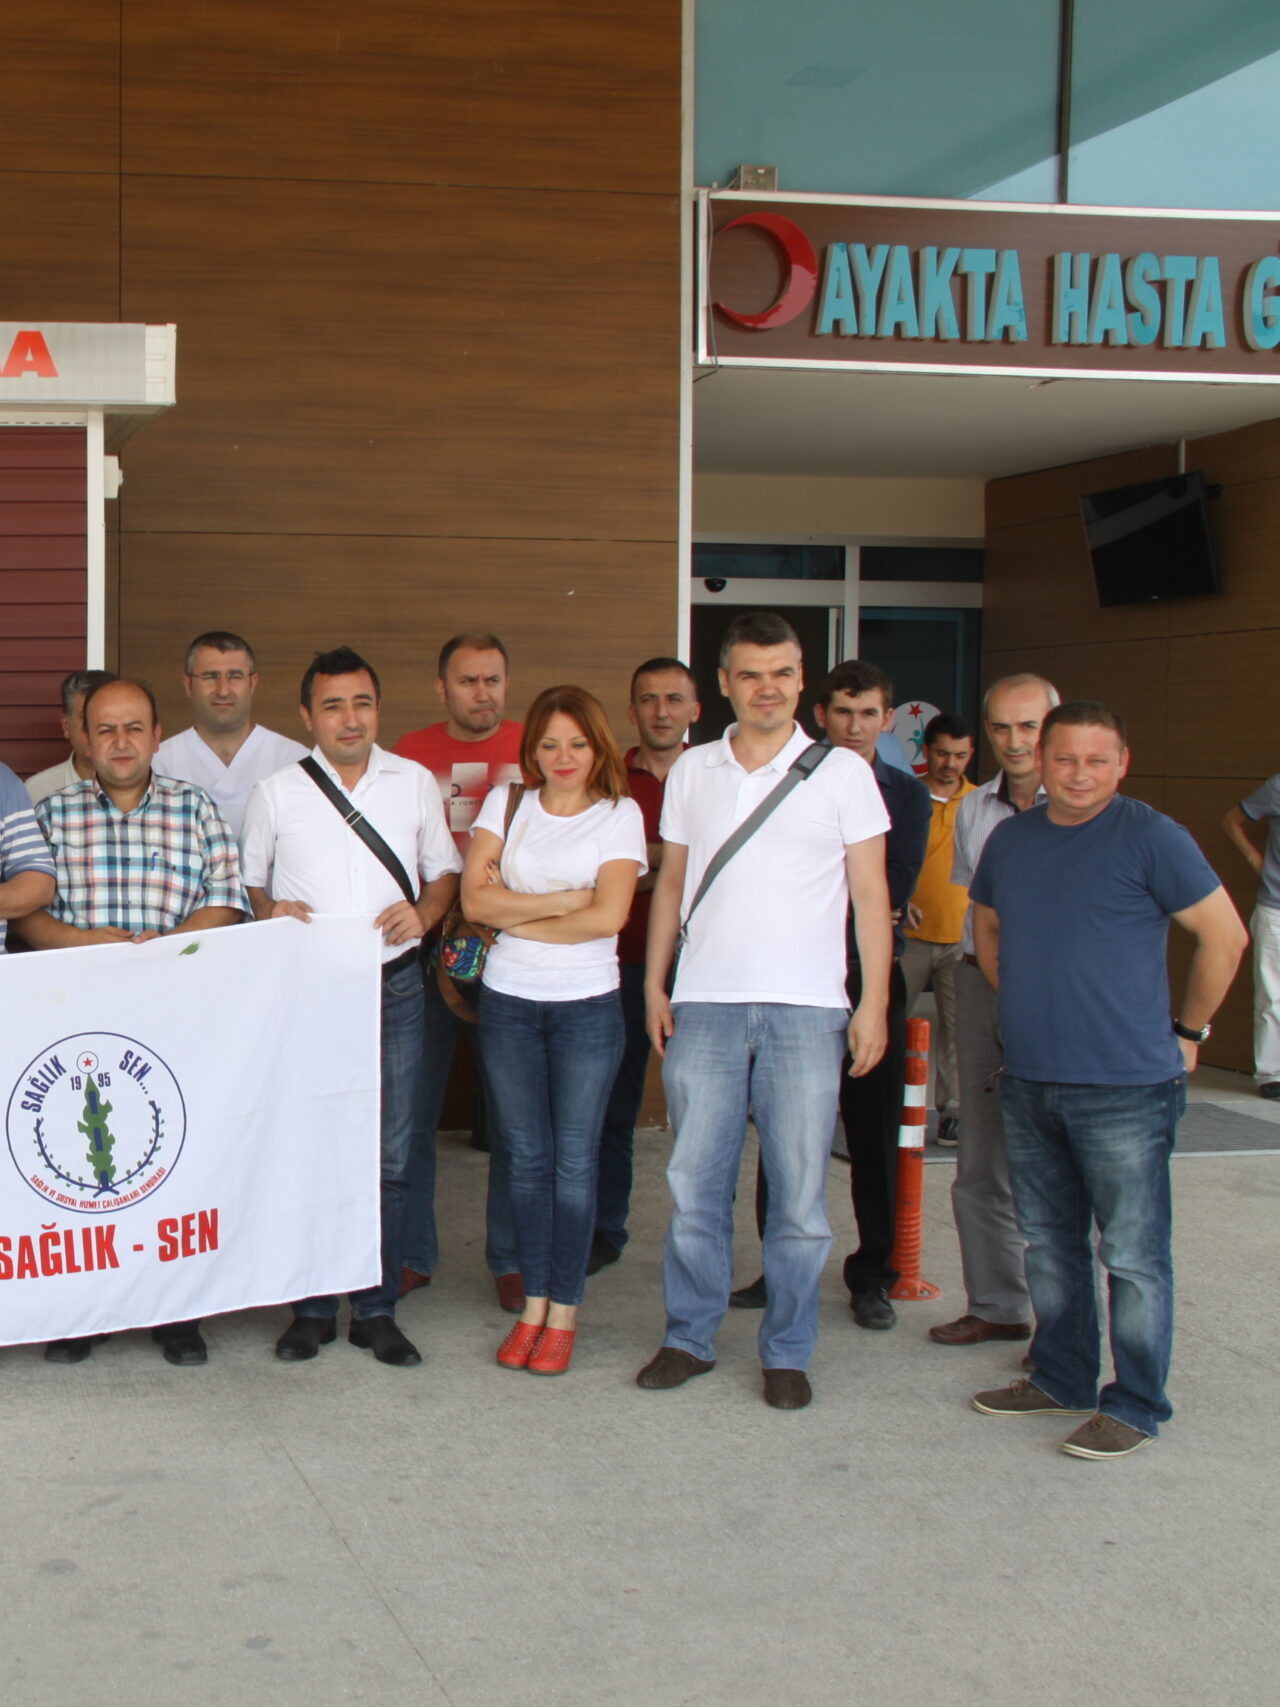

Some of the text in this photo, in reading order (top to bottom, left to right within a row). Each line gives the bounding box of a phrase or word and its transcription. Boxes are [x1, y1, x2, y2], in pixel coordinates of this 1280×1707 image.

[815, 241, 1028, 342] AYAKTA
[1052, 251, 1227, 348] HASTA
[21, 1054, 67, 1113] SAĞLIK
[157, 1207, 219, 1263] SEN
